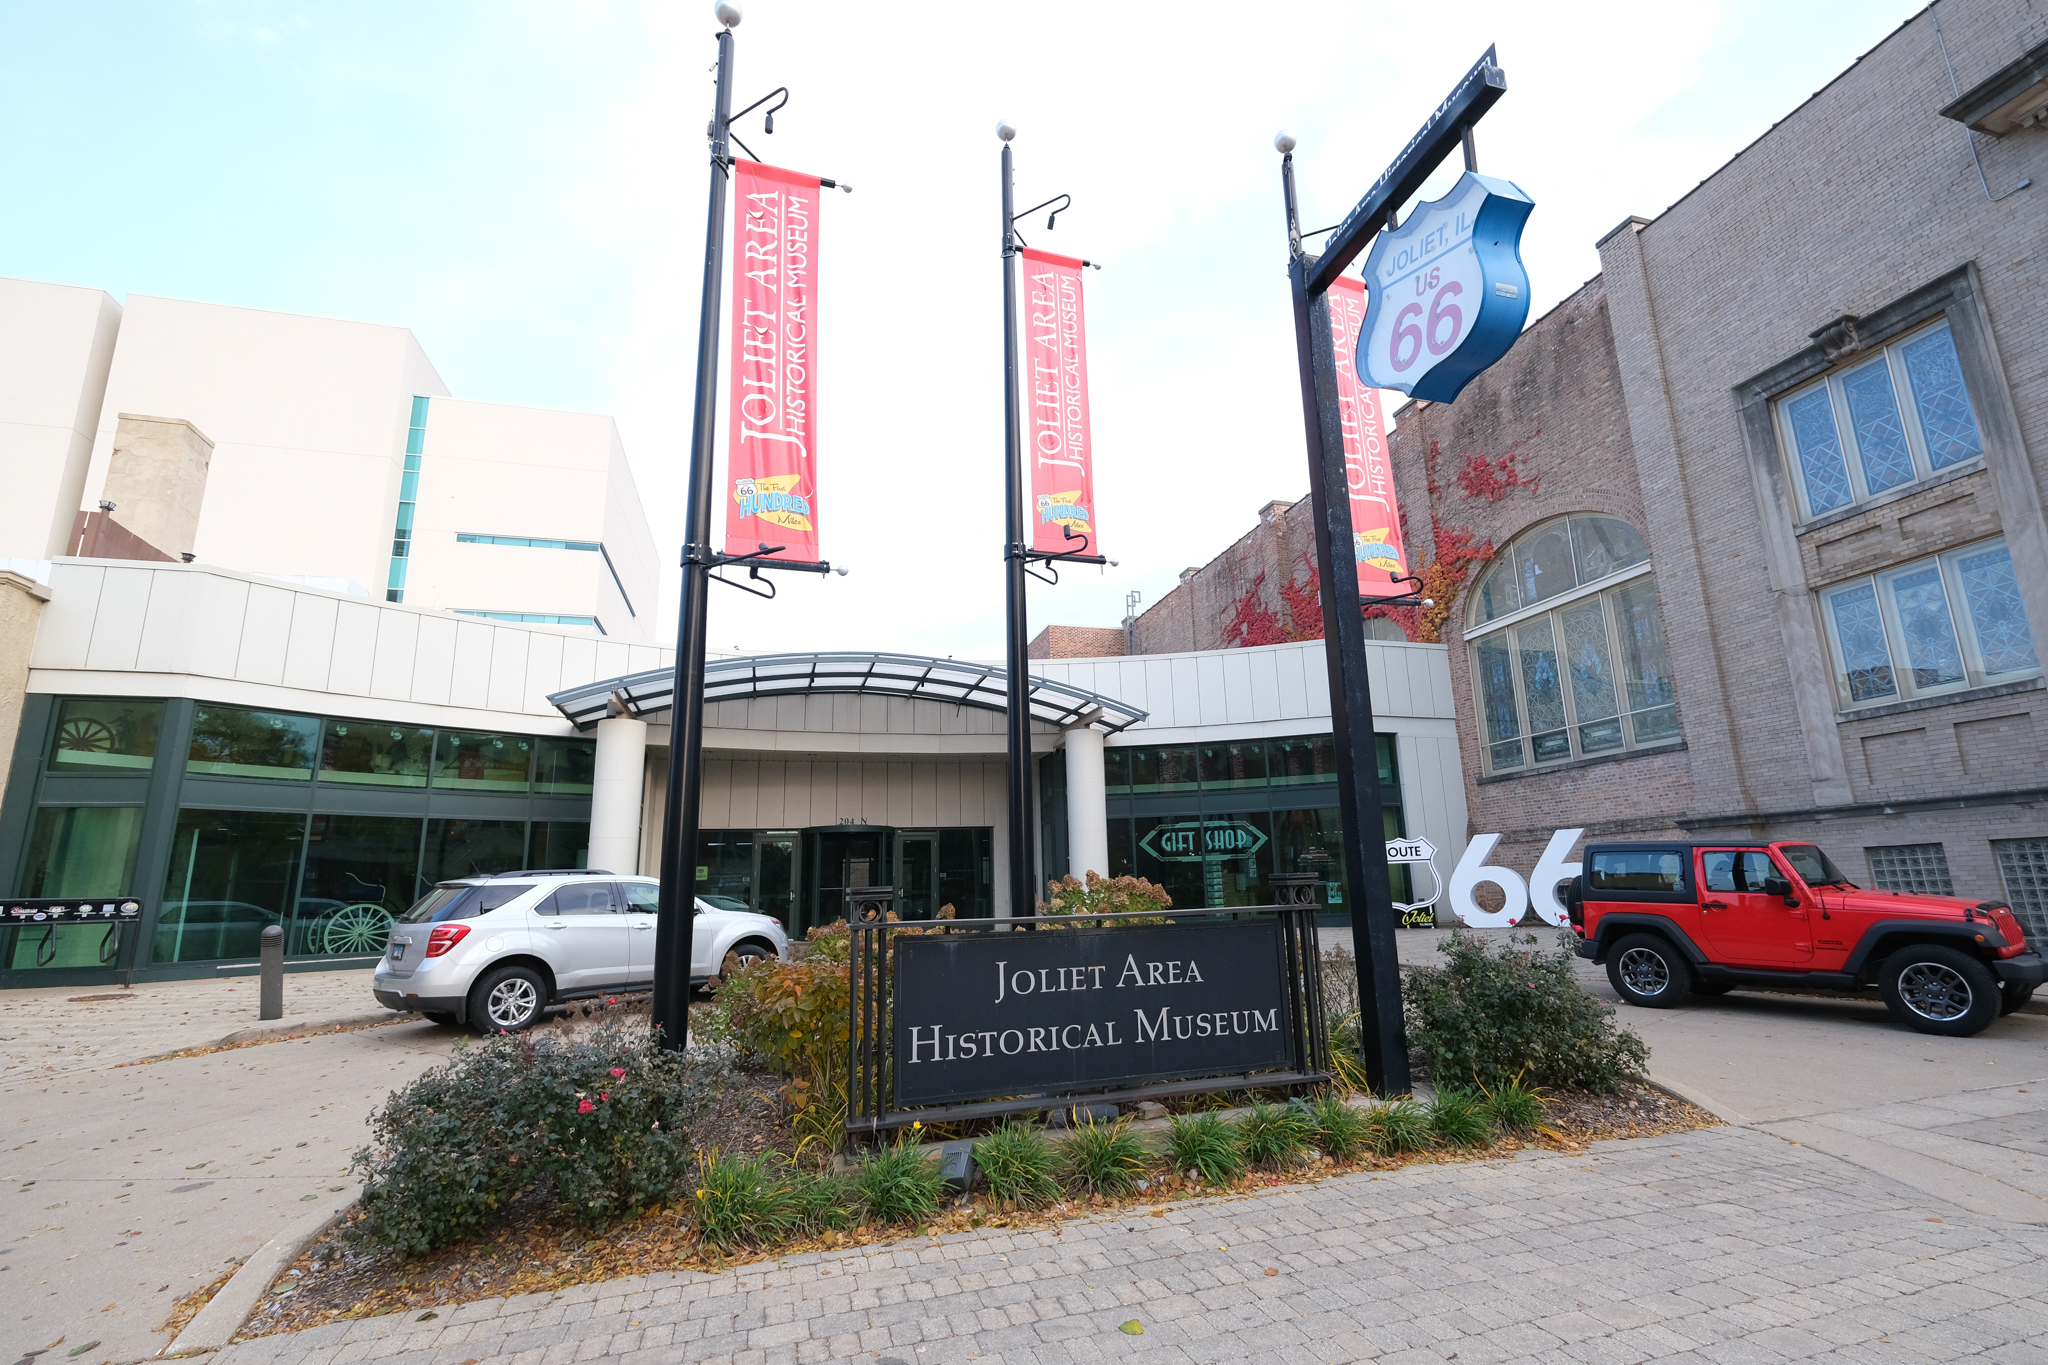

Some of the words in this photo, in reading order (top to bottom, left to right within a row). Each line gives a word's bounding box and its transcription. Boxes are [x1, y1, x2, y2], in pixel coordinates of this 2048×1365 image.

[745, 190, 779, 294] AREA
[787, 196, 809, 288] MUSEUM
[1387, 226, 1449, 277] JOLIET,
[1455, 212, 1472, 236] IL
[1415, 266, 1440, 297] US
[1031, 271, 1058, 354] AREA
[1061, 275, 1078, 348] MUSEUM
[1328, 292, 1352, 380] AREA
[1389, 280, 1463, 373] 66
[741, 298, 807, 457] JOLIET
[786, 294, 807, 436] HISTORICAL
[1034, 357, 1085, 477] JOLIET
[1064, 353, 1084, 460] HISTORICAL
[740, 487, 754, 495] 66
[740, 491, 810, 520] HUNDRED
[757, 483, 770, 491] The
[1041, 504, 1090, 525] HUNDRED
[777, 514, 801, 525] Miles
[1355, 542, 1399, 564] HUNDRED
[839, 817, 855, 826] 204
[861, 817, 868, 826] N
[1161, 831, 1195, 852] GIFT
[1205, 829, 1247, 850] SHOP
[1388, 845, 1422, 858] OUTE
[1449, 828, 1585, 929] 66
[1402, 910, 1435, 925] Joliet
[994, 961, 1106, 1004] JOLIET
[1115, 953, 1204, 988] AREA
[907, 1021, 1123, 1064] HISTORICAL
[1133, 1006, 1280, 1044] MUSEUM
